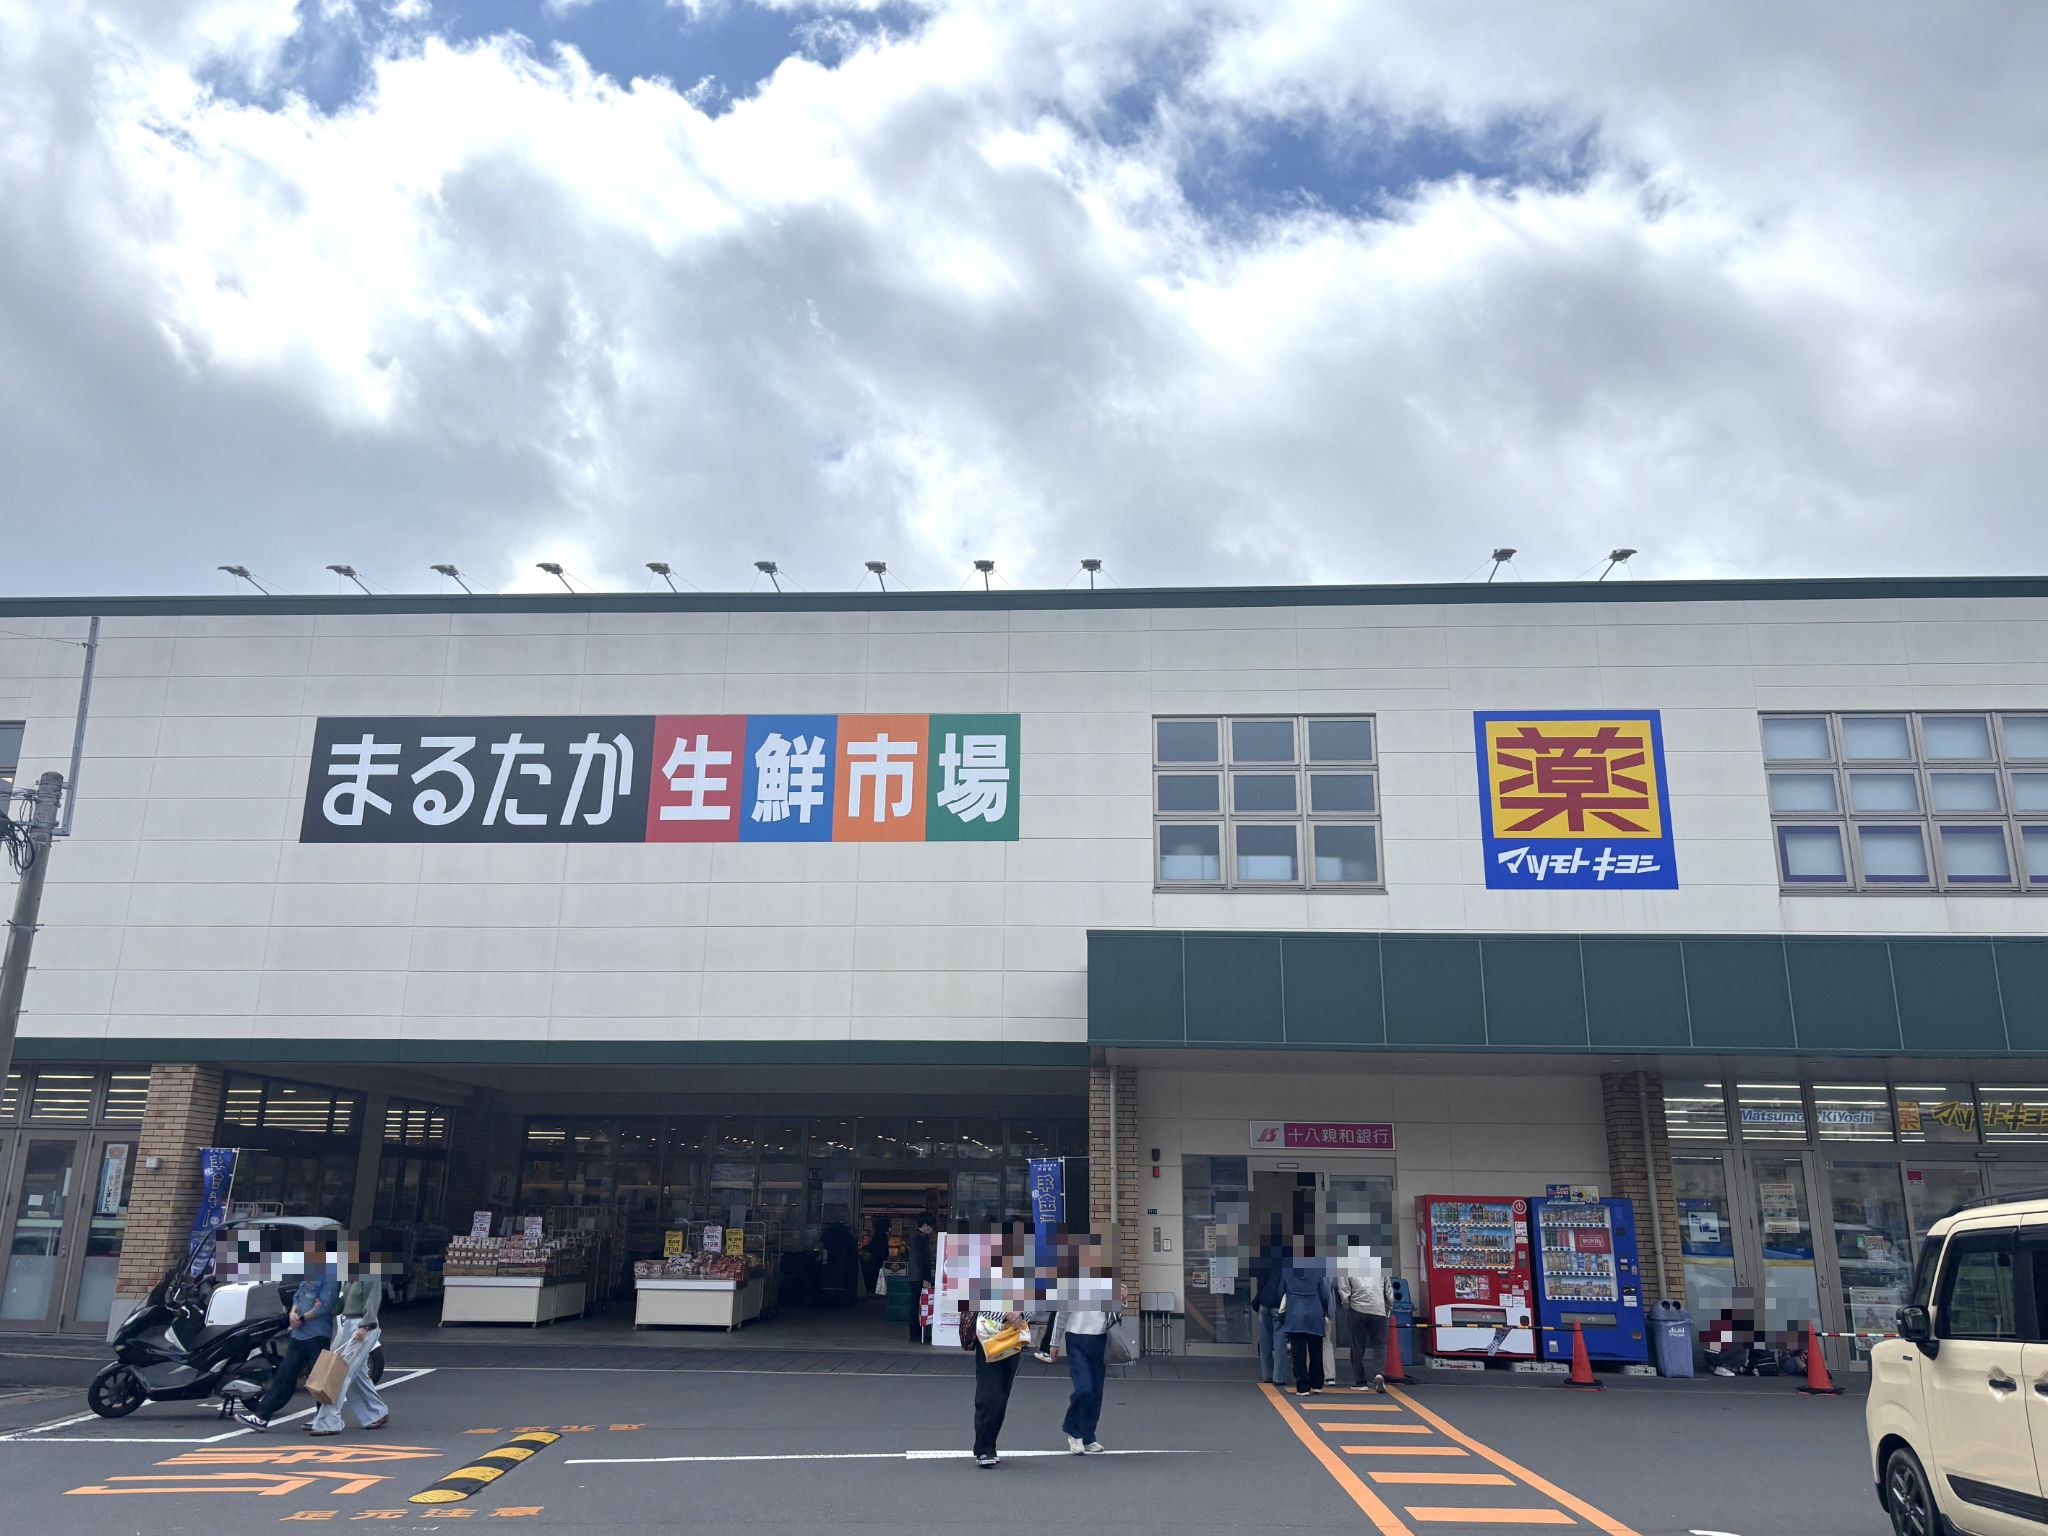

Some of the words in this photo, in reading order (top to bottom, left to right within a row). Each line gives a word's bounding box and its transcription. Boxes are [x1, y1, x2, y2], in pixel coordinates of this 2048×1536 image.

[322, 732, 1010, 827] まるたか生鮮市場
[1496, 727, 1651, 832] 薬
[1497, 846, 1661, 881] マツモトキヨシ
[1288, 1128, 1389, 1144] 十八親和銀行
[280, 1506, 545, 1521] 足元注意
